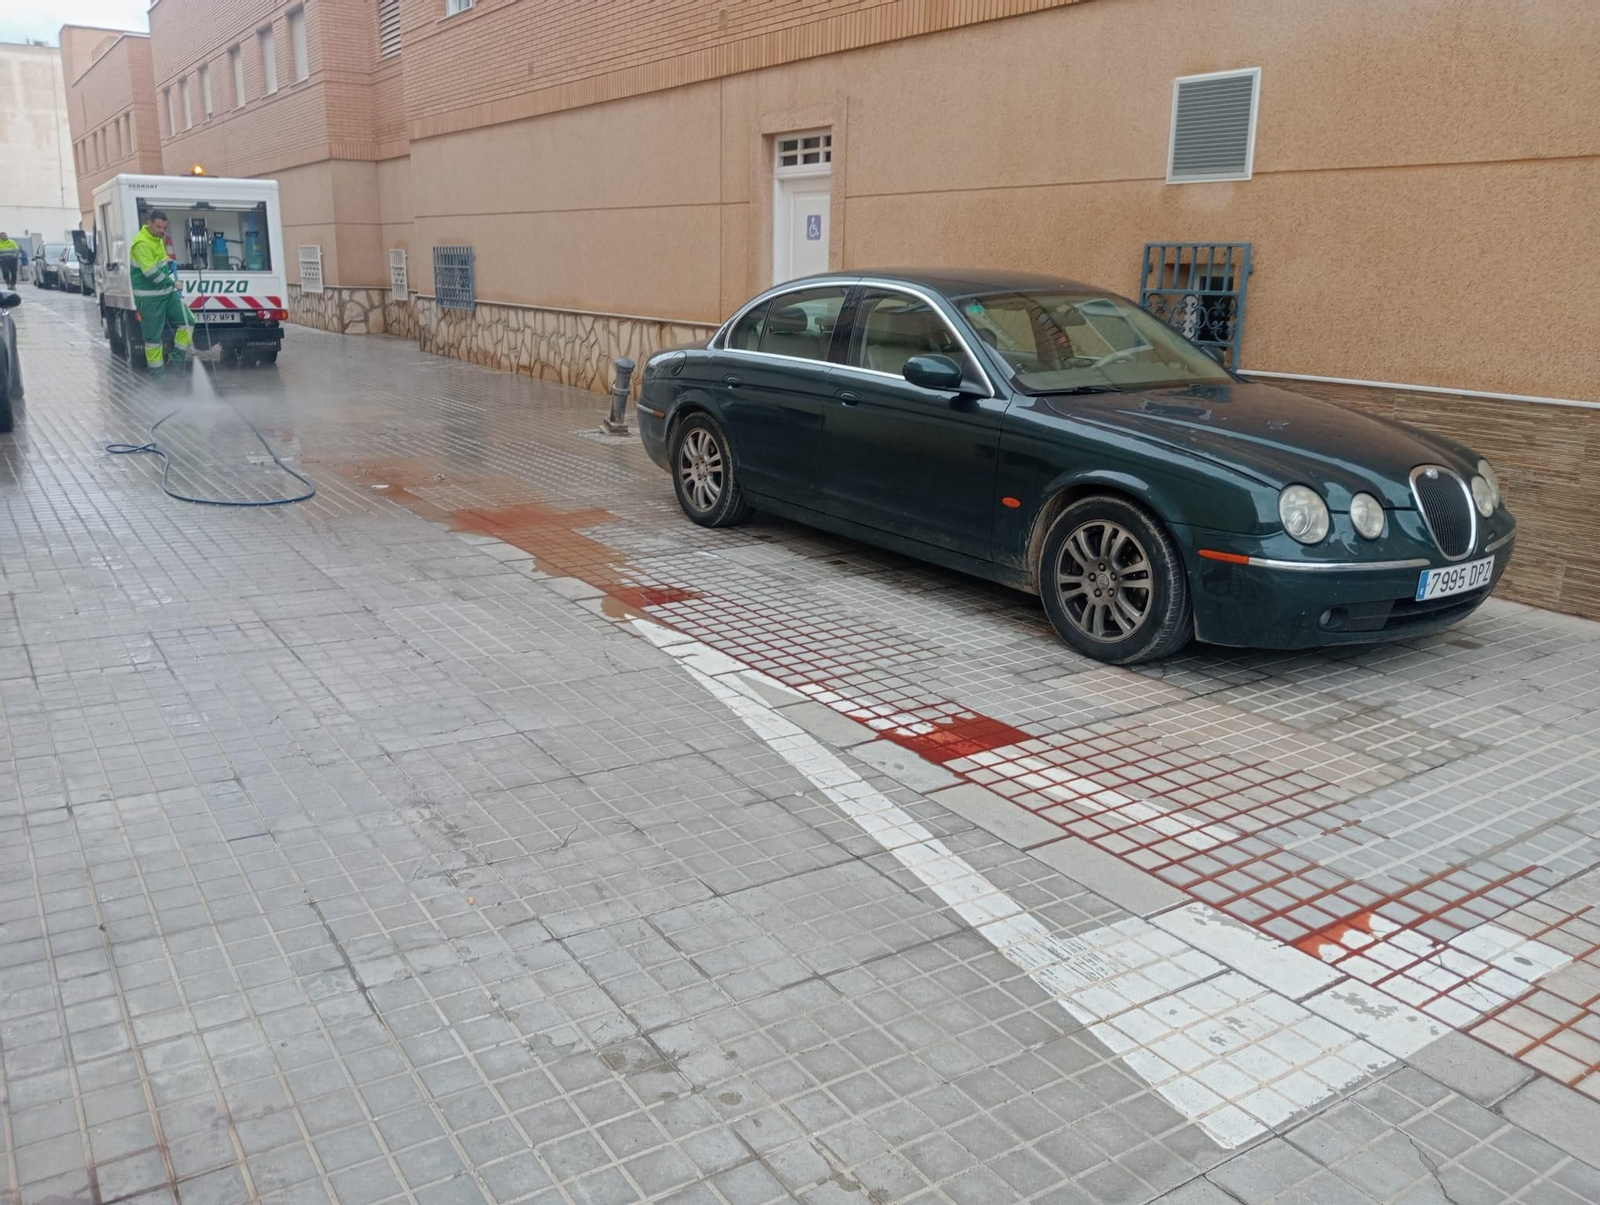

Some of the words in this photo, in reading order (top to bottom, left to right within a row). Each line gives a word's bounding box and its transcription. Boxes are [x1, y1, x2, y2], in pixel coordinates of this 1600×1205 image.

[181, 280, 249, 294] vanza
[1429, 567, 1467, 596] 7995
[1468, 560, 1492, 587] DPZ
